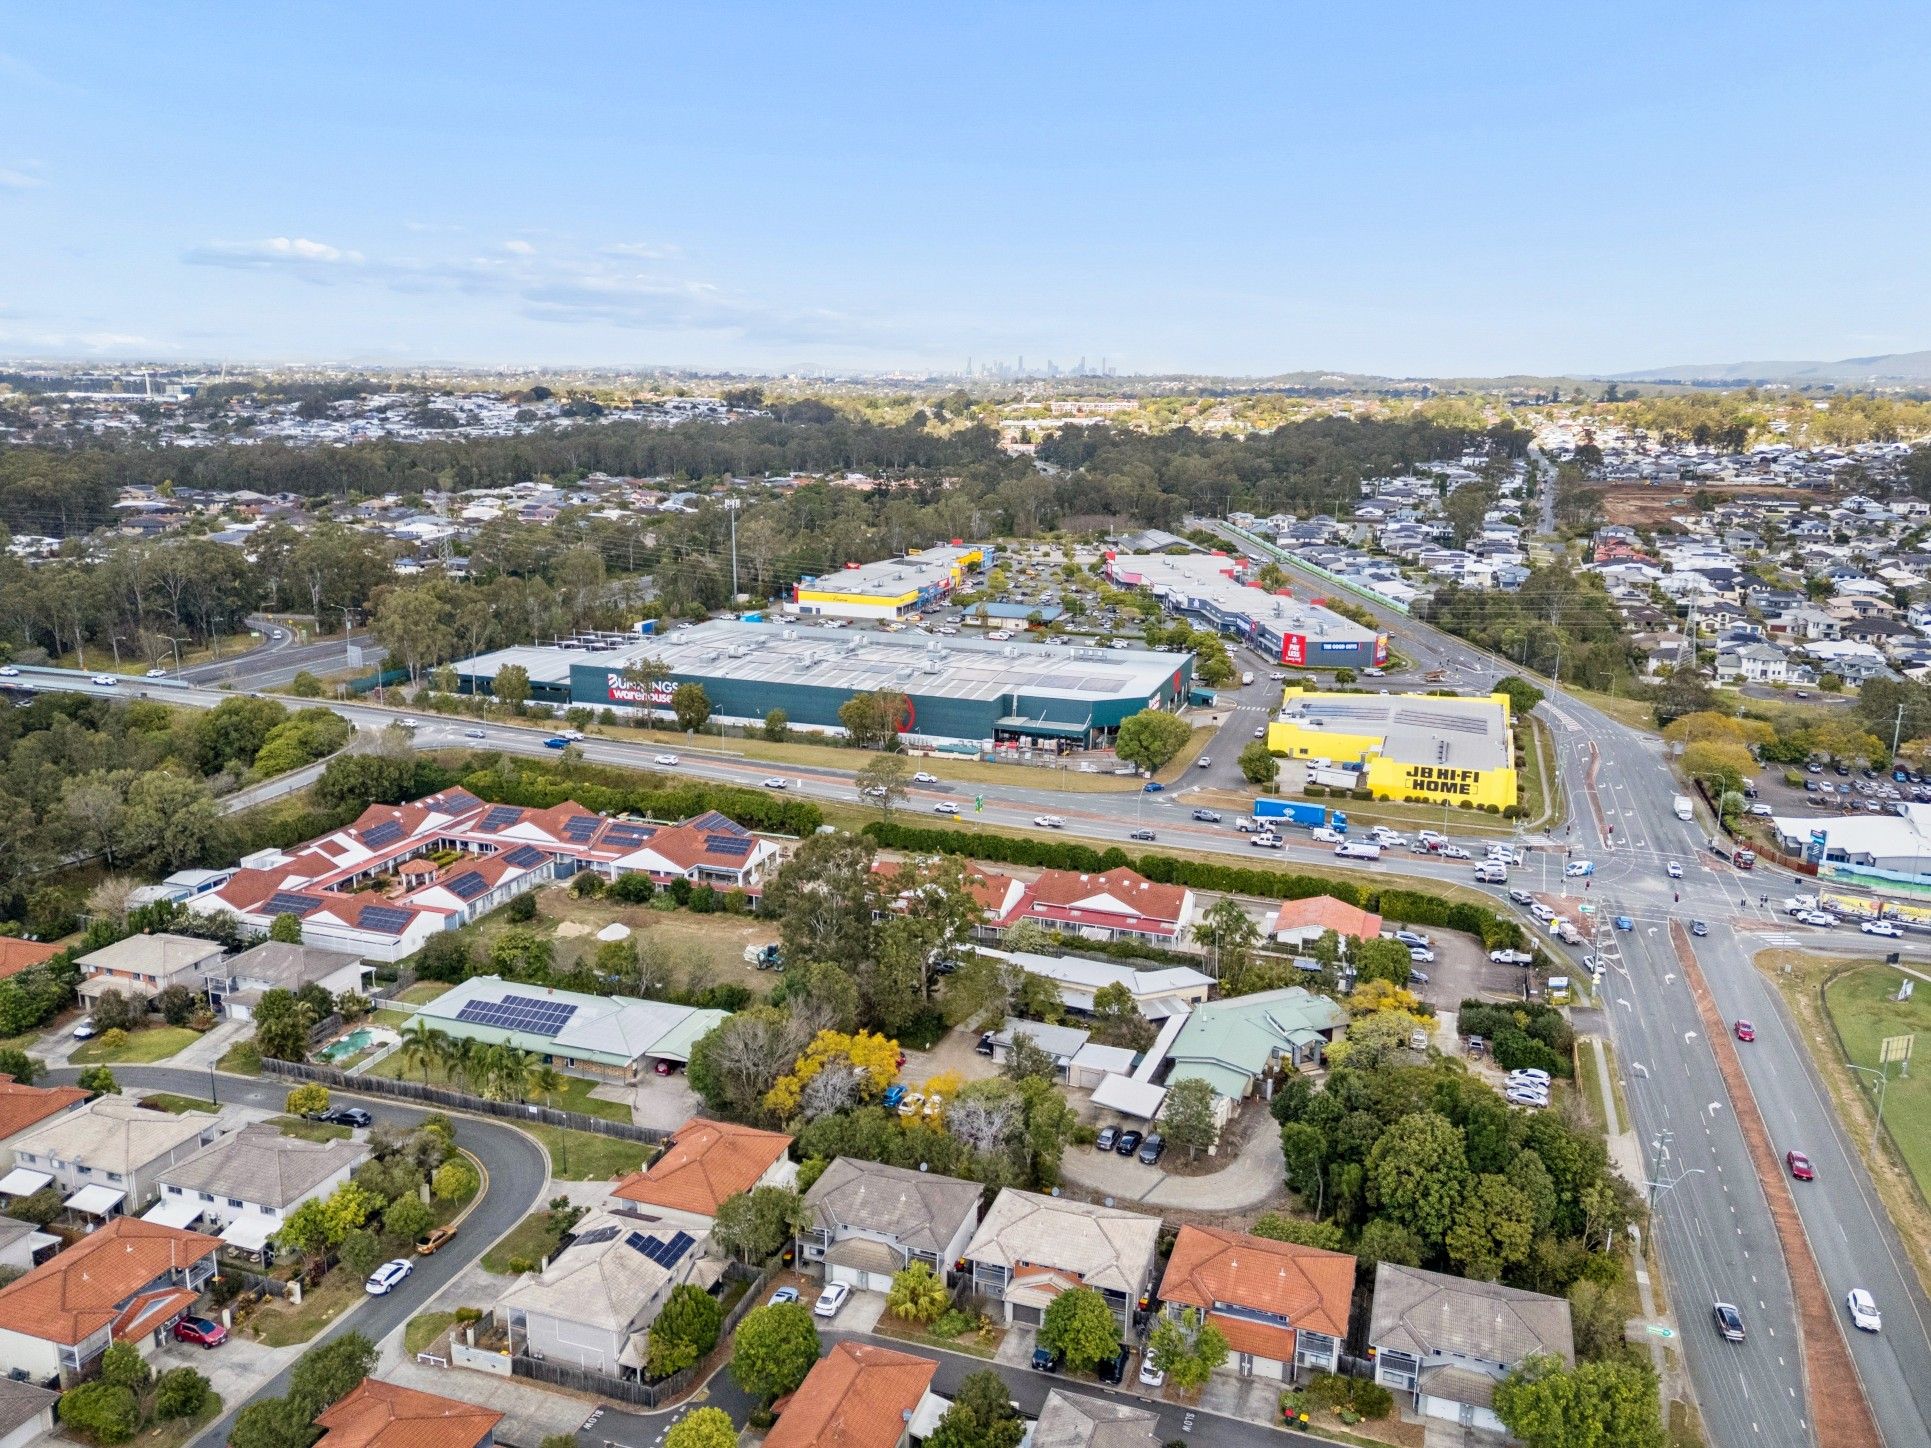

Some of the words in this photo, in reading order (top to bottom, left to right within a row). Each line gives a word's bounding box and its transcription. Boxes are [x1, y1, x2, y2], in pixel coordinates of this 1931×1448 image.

[1406, 766, 1434, 779] JB
[1412, 779, 1471, 795] HOME
[583, 1409, 604, 1430] SLOW
[1182, 1412, 1195, 1433] SLOW
